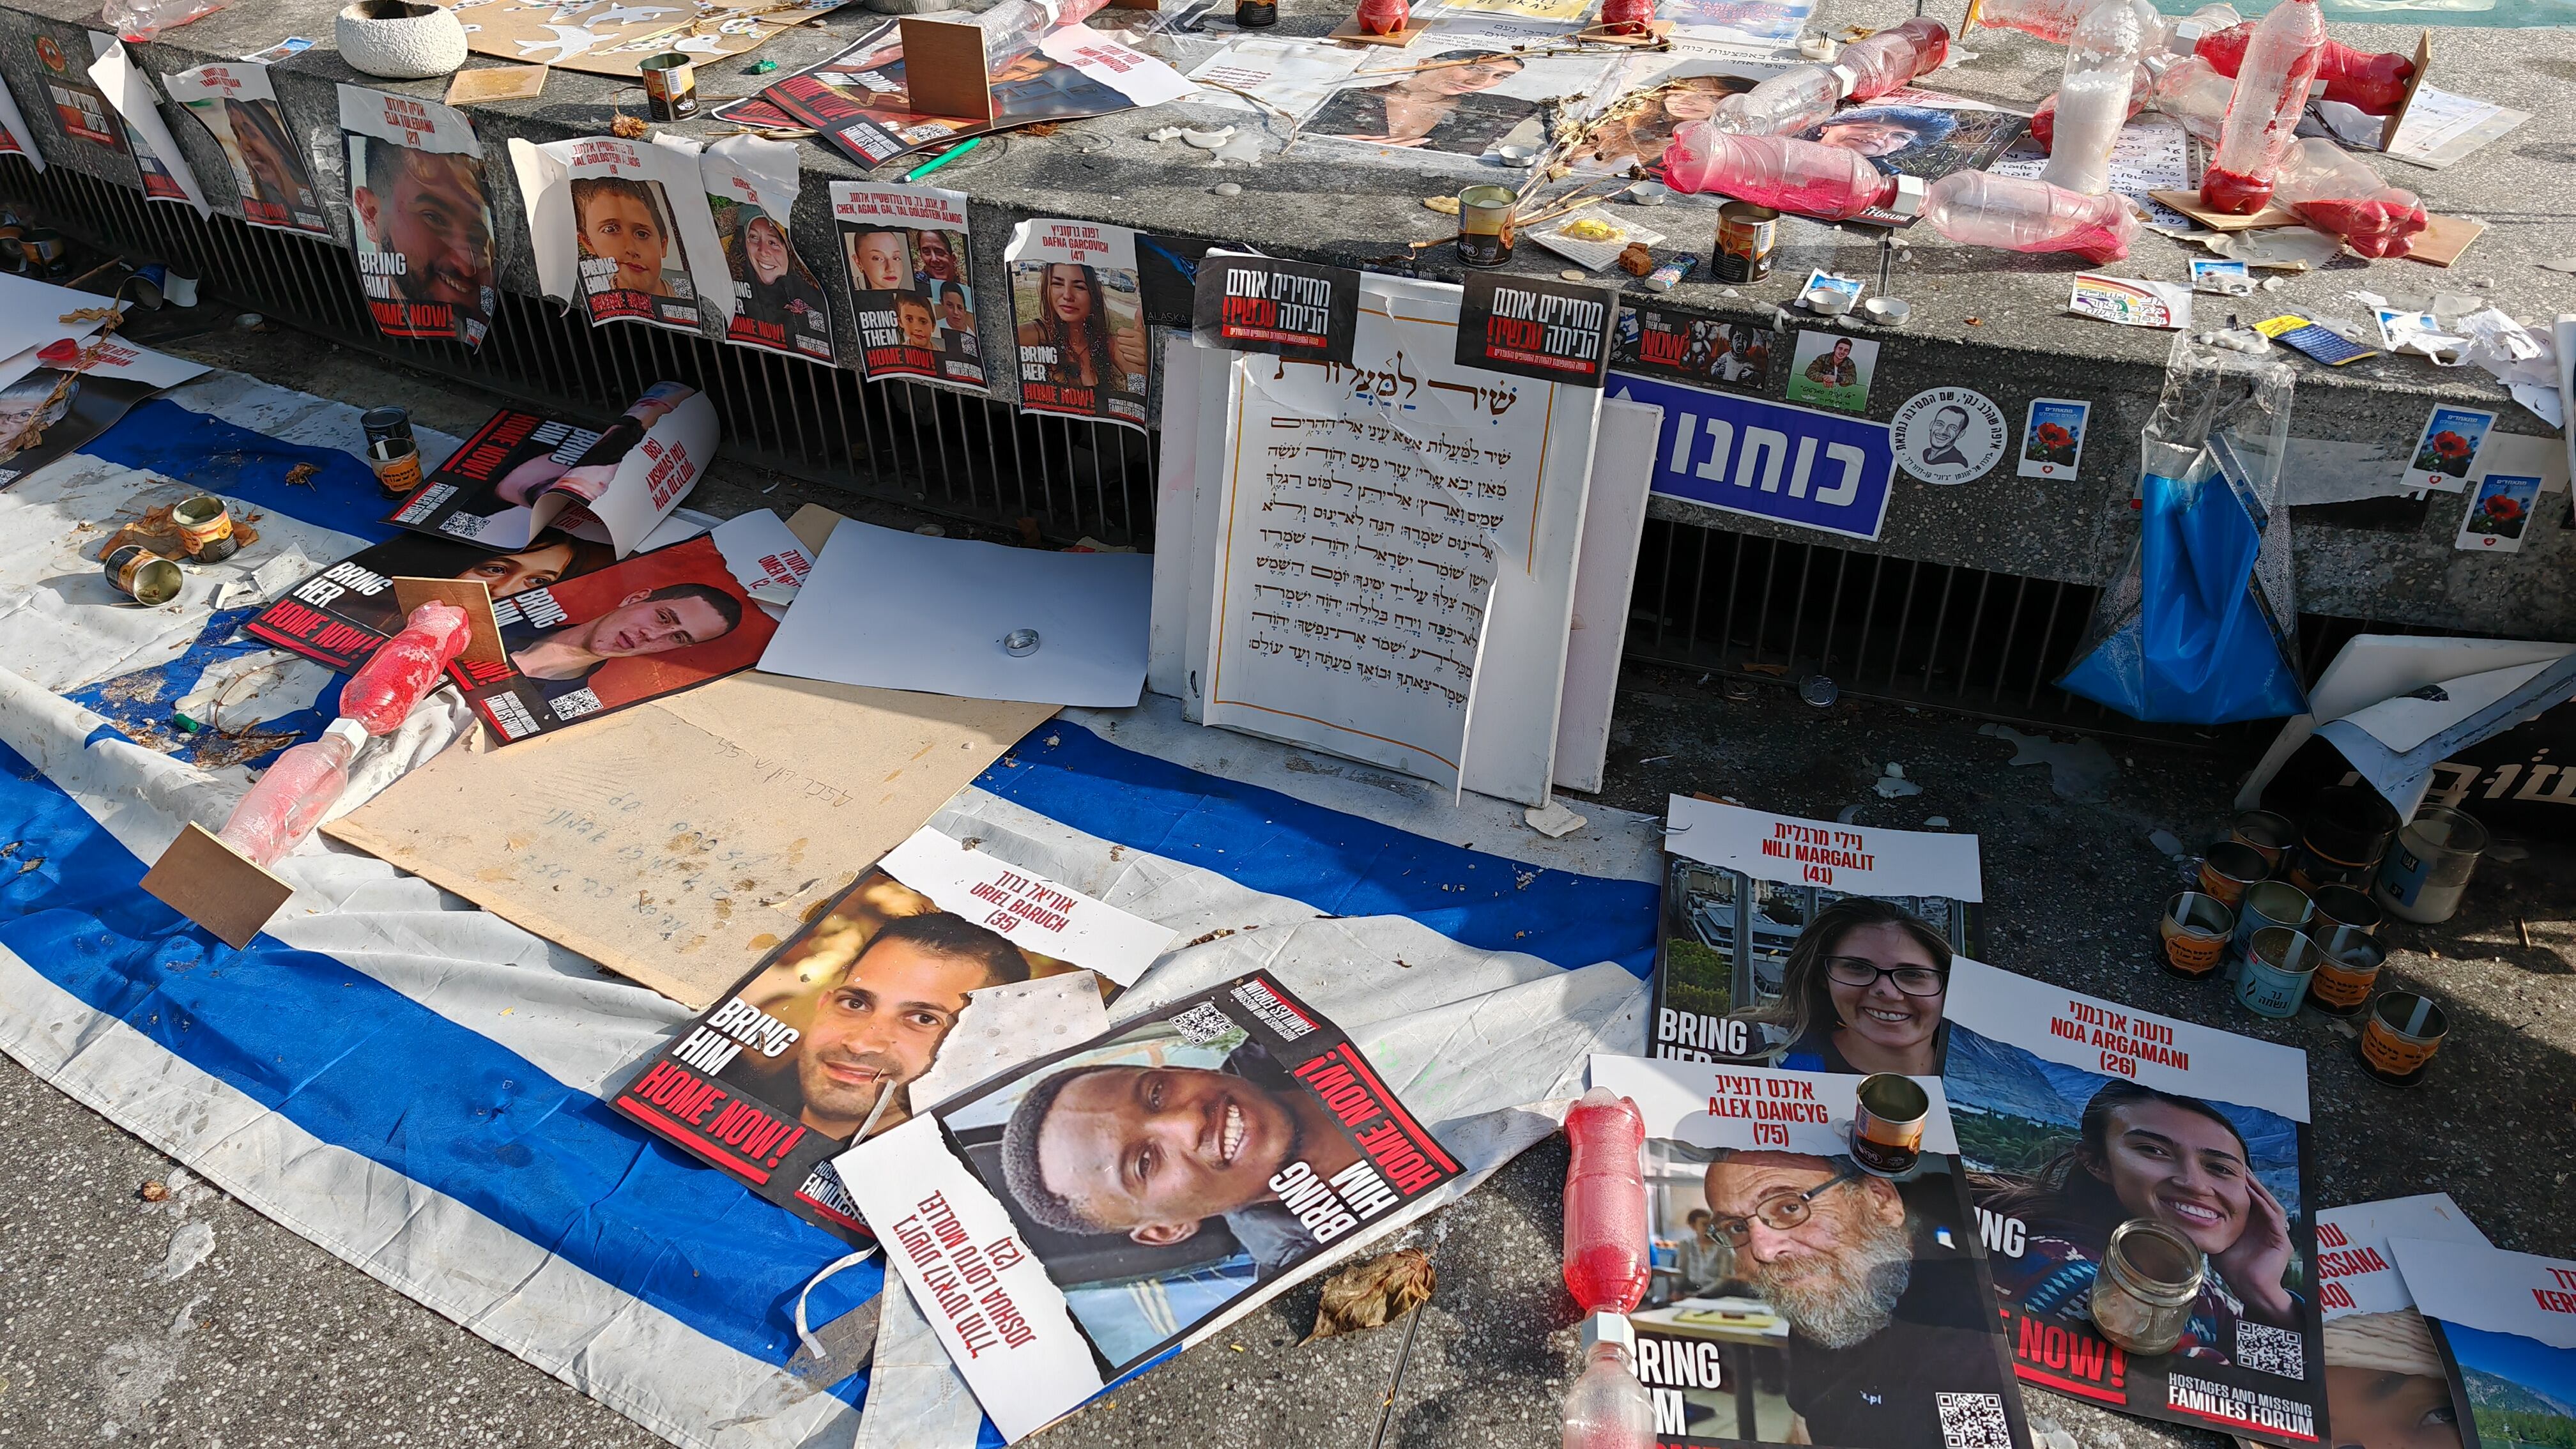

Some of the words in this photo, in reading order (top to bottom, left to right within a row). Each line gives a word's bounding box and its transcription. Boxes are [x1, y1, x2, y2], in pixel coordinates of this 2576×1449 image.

[399, 114, 435, 134] TOLEDANO
[836, 204, 857, 215] CHEN,
[858, 204, 880, 216] AGAM,
[882, 204, 896, 217] GAL,
[894, 206, 909, 217] TAL
[909, 206, 942, 220] GOLDSTEIN
[942, 210, 963, 224] ALMOG
[1043, 236, 1067, 249] DAFNA
[1069, 238, 1109, 254] GARCOVICH
[1071, 250, 1085, 263] (47)
[358, 250, 406, 275] BRING
[363, 275, 390, 299] HIM
[1226, 268, 1268, 298] אותם
[1271, 272, 1331, 308] מחזירים
[371, 301, 406, 327] HOME
[409, 303, 456, 330] NOW!
[1147, 311, 1187, 324] ALASKA
[1222, 296, 1276, 328] עכשיו!
[1279, 302, 1330, 335] הביתה
[1492, 287, 1537, 321] אותם
[1538, 294, 1604, 331] מחזירים
[859, 310, 898, 329] BRING
[1487, 316, 1543, 350] עכשיו!
[862, 328, 899, 348] THEM
[1545, 325, 1600, 360] הביתה
[1641, 329, 1686, 362] NOW
[867, 348, 903, 367] HOME
[904, 348, 936, 369] NOW!
[1020, 346, 1058, 364] BRING
[1022, 363, 1046, 381] HER
[1023, 383, 1058, 402] HOME
[1061, 387, 1096, 408] NOW!
[1902, 394, 1936, 421] המסיבה
[1939, 391, 1954, 401] שם
[1956, 392, 1979, 406] נקי,
[1977, 402, 2000, 425] שהלב
[488, 413, 540, 447] HOME
[530, 420, 573, 446] HIM
[1895, 421, 1908, 451] נמצאת
[1989, 427, 2002, 450] איפה
[550, 426, 602, 467] BRING
[670, 440, 687, 464] ITAI
[1669, 411, 1866, 509] כוחנו
[454, 443, 510, 481] NOW!
[645, 456, 675, 493] SVIRSKY
[323, 560, 394, 597] BRING
[758, 555, 787, 581] OMER
[293, 578, 346, 608] HER
[514, 587, 569, 630] BRING
[261, 599, 329, 640] HOME
[316, 619, 383, 661] NOW!
[1774, 822, 1829, 847] מרגלית
[1834, 831, 1862, 851] נילי
[1762, 838, 1790, 859] NILI
[1795, 845, 1875, 871] MARGALIT
[994, 870, 1030, 894] ברוך
[1803, 863, 1833, 886] (41)
[970, 882, 1012, 908] URIEL
[1007, 898, 1071, 933] BARUCH
[1025, 882, 1078, 914] אוריאל
[983, 909, 1022, 933] (35)
[1243, 980, 1278, 1011] FORUM
[2257, 995, 2289, 1010] נשמה
[2271, 989, 2282, 1000] נר
[705, 996, 801, 1058] BRING
[1275, 1002, 1316, 1038] FAMILIES
[1657, 1007, 1748, 1055] BRING
[2068, 1000, 2128, 1035] ארגמני
[2050, 1016, 2087, 1045] NOA
[2091, 1031, 2189, 1072] ARGAMANI
[2131, 1020, 2174, 1046] נועה
[671, 1025, 743, 1077] HIM
[2099, 1054, 2138, 1079] (26)
[1294, 1051, 1383, 1128] NOW!
[1715, 1074, 1762, 1097] דנציג
[1765, 1078, 1816, 1100] אלכס
[634, 1060, 728, 1126] HOME
[705, 1099, 807, 1169] NOW!
[1708, 1096, 1752, 1119] ALEX
[1756, 1100, 1829, 1124] DANCYG
[1753, 1121, 1790, 1147] (75)
[1355, 1119, 1442, 1196] HOME
[1268, 1161, 1358, 1245] BRING
[1328, 1160, 1399, 1221] HIM
[917, 1189, 970, 1251] MOLLEL
[983, 1235, 1025, 1272] (21)
[950, 1245, 999, 1294] LOITU
[979, 1286, 1038, 1350] JOSHUA
[2018, 1319, 2128, 1389] NOW!
[2168, 1371, 2230, 1399] HOSTAGES
[2231, 1386, 2256, 1405] AND
[2258, 1391, 2312, 1418] MISSING
[2168, 1384, 2248, 1422] FAMILIES
[2250, 1402, 2315, 1438] FORUM
